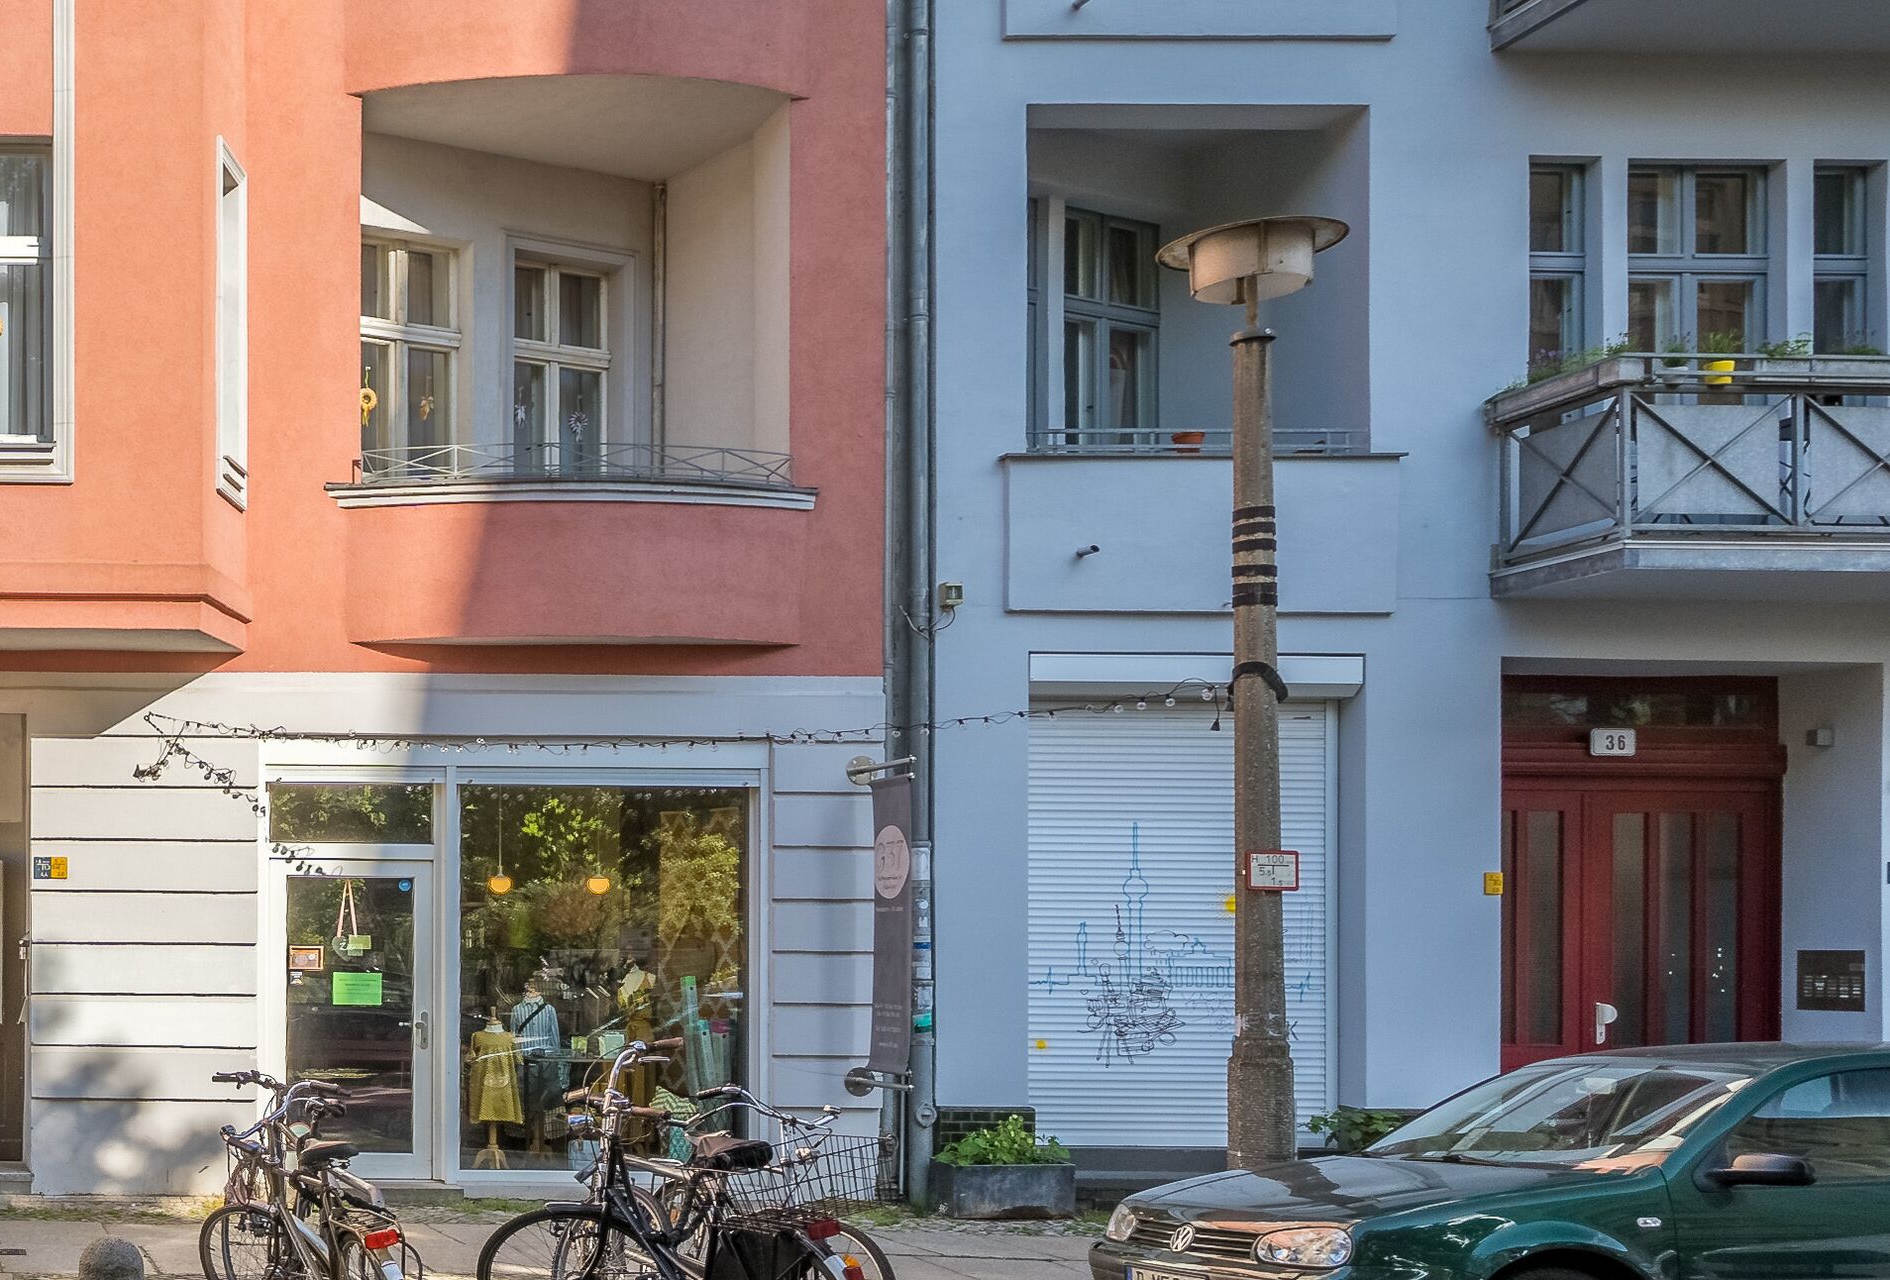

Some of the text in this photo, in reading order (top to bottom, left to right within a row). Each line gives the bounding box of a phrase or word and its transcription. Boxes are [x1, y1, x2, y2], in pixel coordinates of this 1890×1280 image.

[1605, 735, 1626, 750] 36
[1251, 855, 1284, 864] H 100
